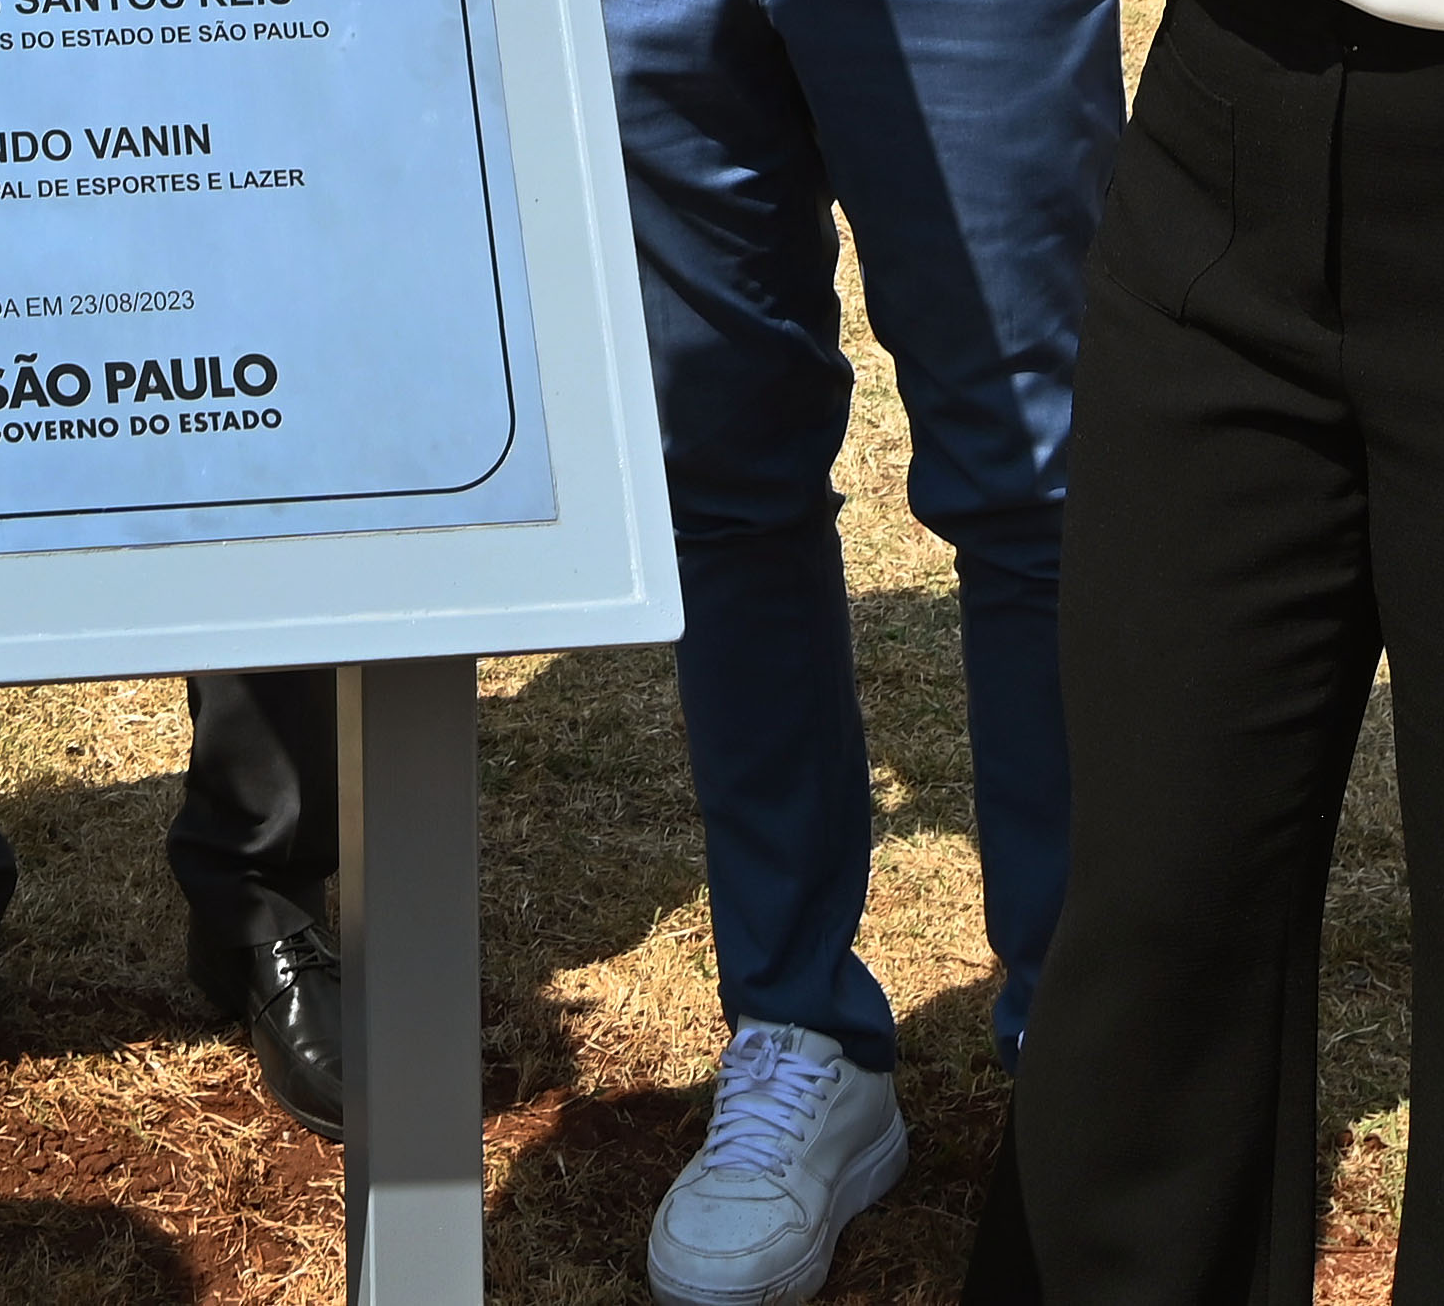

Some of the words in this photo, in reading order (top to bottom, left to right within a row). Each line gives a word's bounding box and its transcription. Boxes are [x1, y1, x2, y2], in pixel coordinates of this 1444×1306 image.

[21, 31, 55, 49] DO
[61, 27, 154, 48] ESTADO
[160, 25, 192, 44] DE
[198, 20, 247, 43] SÃO
[253, 20, 330, 41] PAULO
[84, 123, 211, 159] VANIN
[37, 179, 70, 198] DE
[76, 173, 201, 196] ESPORTES
[207, 172, 223, 190] E
[229, 169, 305, 189] LAZER
[26, 296, 63, 317] EM
[70, 290, 195, 315] 23/08/2023
[104, 353, 278, 404] PAULO
[131, 413, 170, 437] DO
[179, 407, 283, 434] ESTADO
